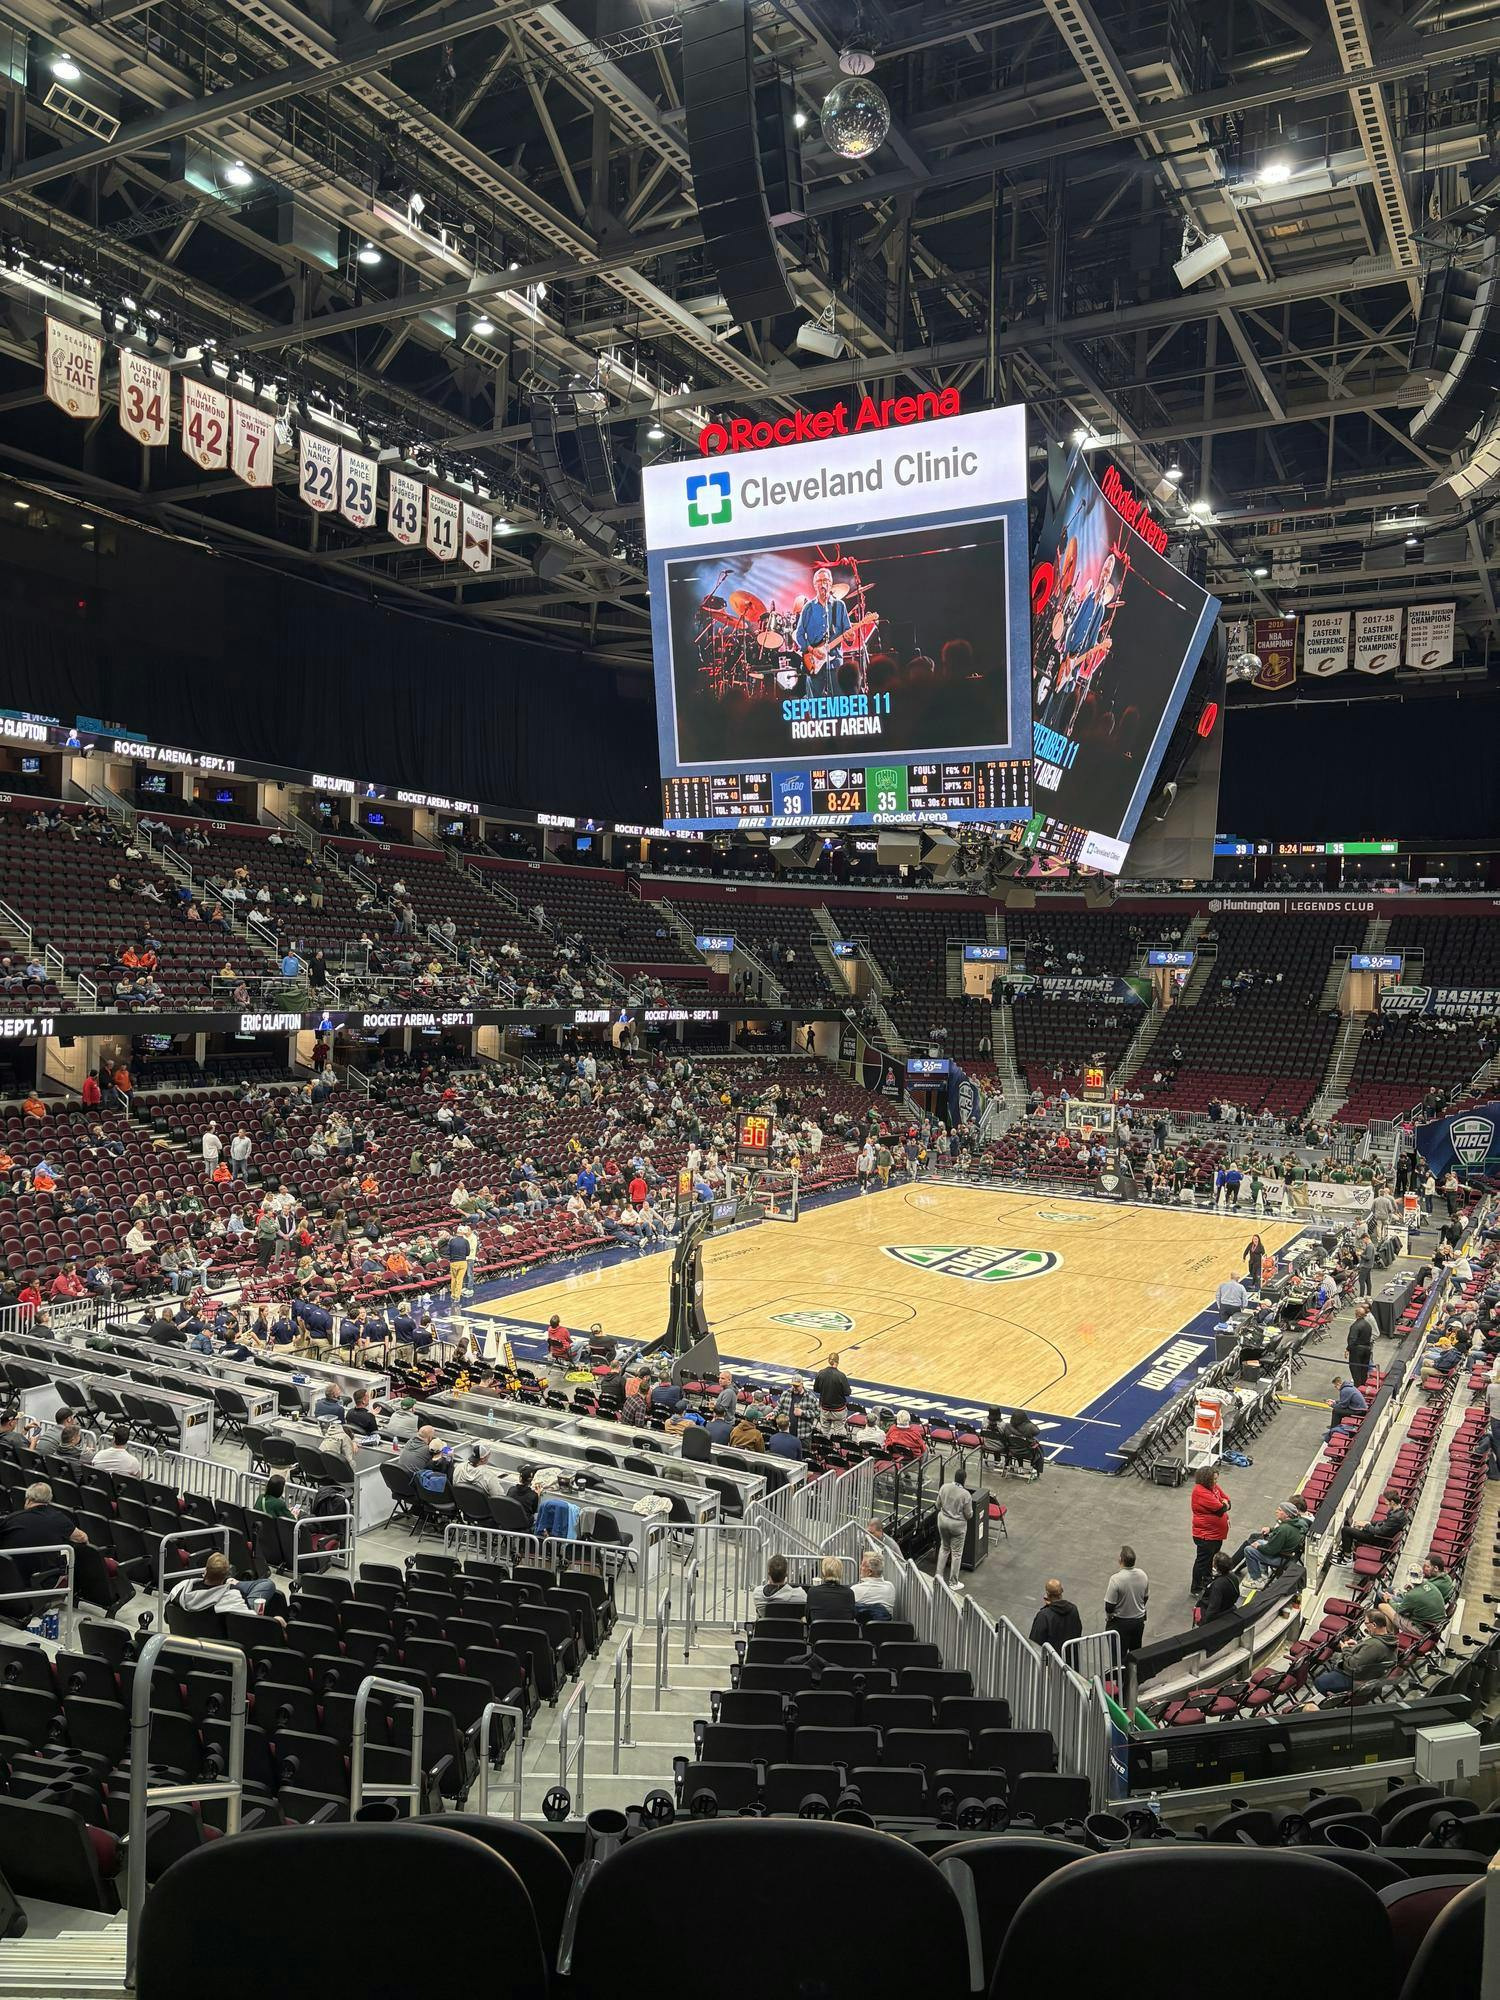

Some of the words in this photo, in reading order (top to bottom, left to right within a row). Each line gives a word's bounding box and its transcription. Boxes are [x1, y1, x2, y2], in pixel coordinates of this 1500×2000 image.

[64, 334, 96, 353] SEASONS
[68, 352, 94, 374] JOE
[64, 366, 96, 390] TAIT
[130, 361, 161, 382] AUSTIN
[134, 374, 158, 390] CARR
[196, 390, 216, 406] NATE
[127, 385, 164, 432] 34
[187, 396, 226, 419] THURMOND
[730, 401, 848, 453] Rocket
[854, 386, 960, 431] Arena
[188, 412, 222, 456] 42
[241, 420, 266, 436] SMITH
[246, 434, 260, 468] 7
[308, 440, 331, 456] LARRY
[308, 450, 331, 465] NANCE
[350, 458, 369, 471] MARK
[304, 460, 333, 500] 22
[350, 467, 369, 480] PRICE
[740, 459, 882, 508] Cleveland
[894, 446, 978, 486] Clinic
[398, 479, 414, 491] BRAD
[346, 478, 372, 515] 25
[431, 494, 457, 510] ZYDRUNAS
[392, 498, 417, 533] 43
[472, 511, 484, 522] NICK
[1105, 473, 1142, 527] Rocket
[1135, 508, 1168, 554] Arena
[466, 517, 488, 532] GILBERT
[434, 516, 451, 548] 11
[1268, 620, 1284, 628] 2016
[1312, 618, 1343, 627] 2016-17
[1363, 614, 1395, 624] 2017-18
[1411, 615, 1451, 624] CHAMPIONS
[1268, 632, 1282, 640] NBA
[1312, 628, 1340, 637] EASTERN
[1364, 625, 1393, 634] EASTERN
[1258, 640, 1293, 649] CHAMPIONS
[1307, 637, 1346, 646] CONFERENCE
[1358, 633, 1399, 643] CONFERENCE
[1308, 646, 1344, 655] CHAMPIONS
[1359, 643, 1396, 652] CHAMPIONS
[782, 694, 868, 721] SEPTEMBER
[874, 692, 890, 714] 11
[4, 720, 47, 742] CLAPTON
[791, 719, 837, 739] ROCKET
[840, 716, 882, 736] ARENA
[114, 741, 157, 760] ROCKET
[158, 748, 192, 766] ARENA
[200, 756, 226, 771] SEPT.
[227, 760, 235, 772] 11
[1063, 741, 1080, 770] 11
[914, 766, 936, 775] FOULS
[962, 766, 970, 774] 47
[745, 774, 766, 783] FOULS
[852, 773, 863, 784] 30
[922, 776, 928, 784] 0
[1037, 763, 1063, 792] ARENA
[313, 775, 327, 788] ERIC
[328, 777, 355, 794] CLAPTON
[780, 782, 804, 793] TOLEDO
[814, 779, 825, 790] 2H
[945, 782, 961, 790] 3PT%
[398, 791, 426, 804] ROCKET
[427, 795, 450, 809] ARENA
[455, 801, 473, 813] SEPT.
[473, 804, 479, 814] 11
[713, 792, 728, 800] 3PT%
[827, 792, 860, 811] 8:24
[878, 792, 897, 811] 35
[911, 798, 925, 807] TOL:
[941, 798, 946, 806] 2
[949, 797, 965, 806] FULL
[967, 797, 970, 805] 1
[715, 806, 728, 815] TOL:
[742, 806, 747, 814] 2
[750, 805, 764, 813] FULL
[766, 805, 769, 813] 1
[784, 795, 801, 814] 39
[537, 814, 550, 826] ERIC
[550, 815, 576, 828] CLAPTON
[738, 818, 766, 827] MAC
[772, 815, 852, 826] TOURNAMENT
[882, 812, 917, 823] Rocket
[918, 812, 947, 822] Arena
[217, 822, 226, 830] 121
[615, 824, 642, 836] ROCKET
[645, 828, 671, 838] ARENA
[697, 832, 703, 840] 11
[1236, 845, 1247, 854] 39
[1258, 845, 1267, 854] 30
[1279, 844, 1297, 854] 8:24
[1302, 844, 1315, 852] HALF
[1333, 843, 1344, 853] 35
[1222, 898, 1280, 913] Huntington
[1292, 902, 1341, 911] LEGENDS
[1344, 902, 1374, 911] CLUB
[1166, 952, 1178, 963] 25
[1370, 957, 1383, 968] 25
[1042, 978, 1114, 991] WELCOME
[1380, 996, 1424, 1008] MAC
[241, 1014, 261, 1031] ERIC
[262, 1013, 301, 1030] CLAPTON
[363, 1014, 402, 1027] ROCKET
[404, 1014, 434, 1026] ARENA
[442, 1013, 465, 1025] SEPT.
[466, 1013, 473, 1024] 11
[575, 1011, 588, 1023] ERIC
[589, 1010, 610, 1022] CLAPTON
[645, 1011, 669, 1021] ROCKET
[669, 1011, 689, 1020] ARENA
[693, 1011, 712, 1020] SEPT.
[713, 1010, 718, 1020] 11
[41, 1018, 53, 1035] 11
[922, 1061, 934, 1071] 25
[1086, 1075, 1101, 1087] 30
[747, 1116, 767, 1128] 8:24
[743, 1127, 765, 1146] 30
[1455, 1134, 1490, 1147] MAC
